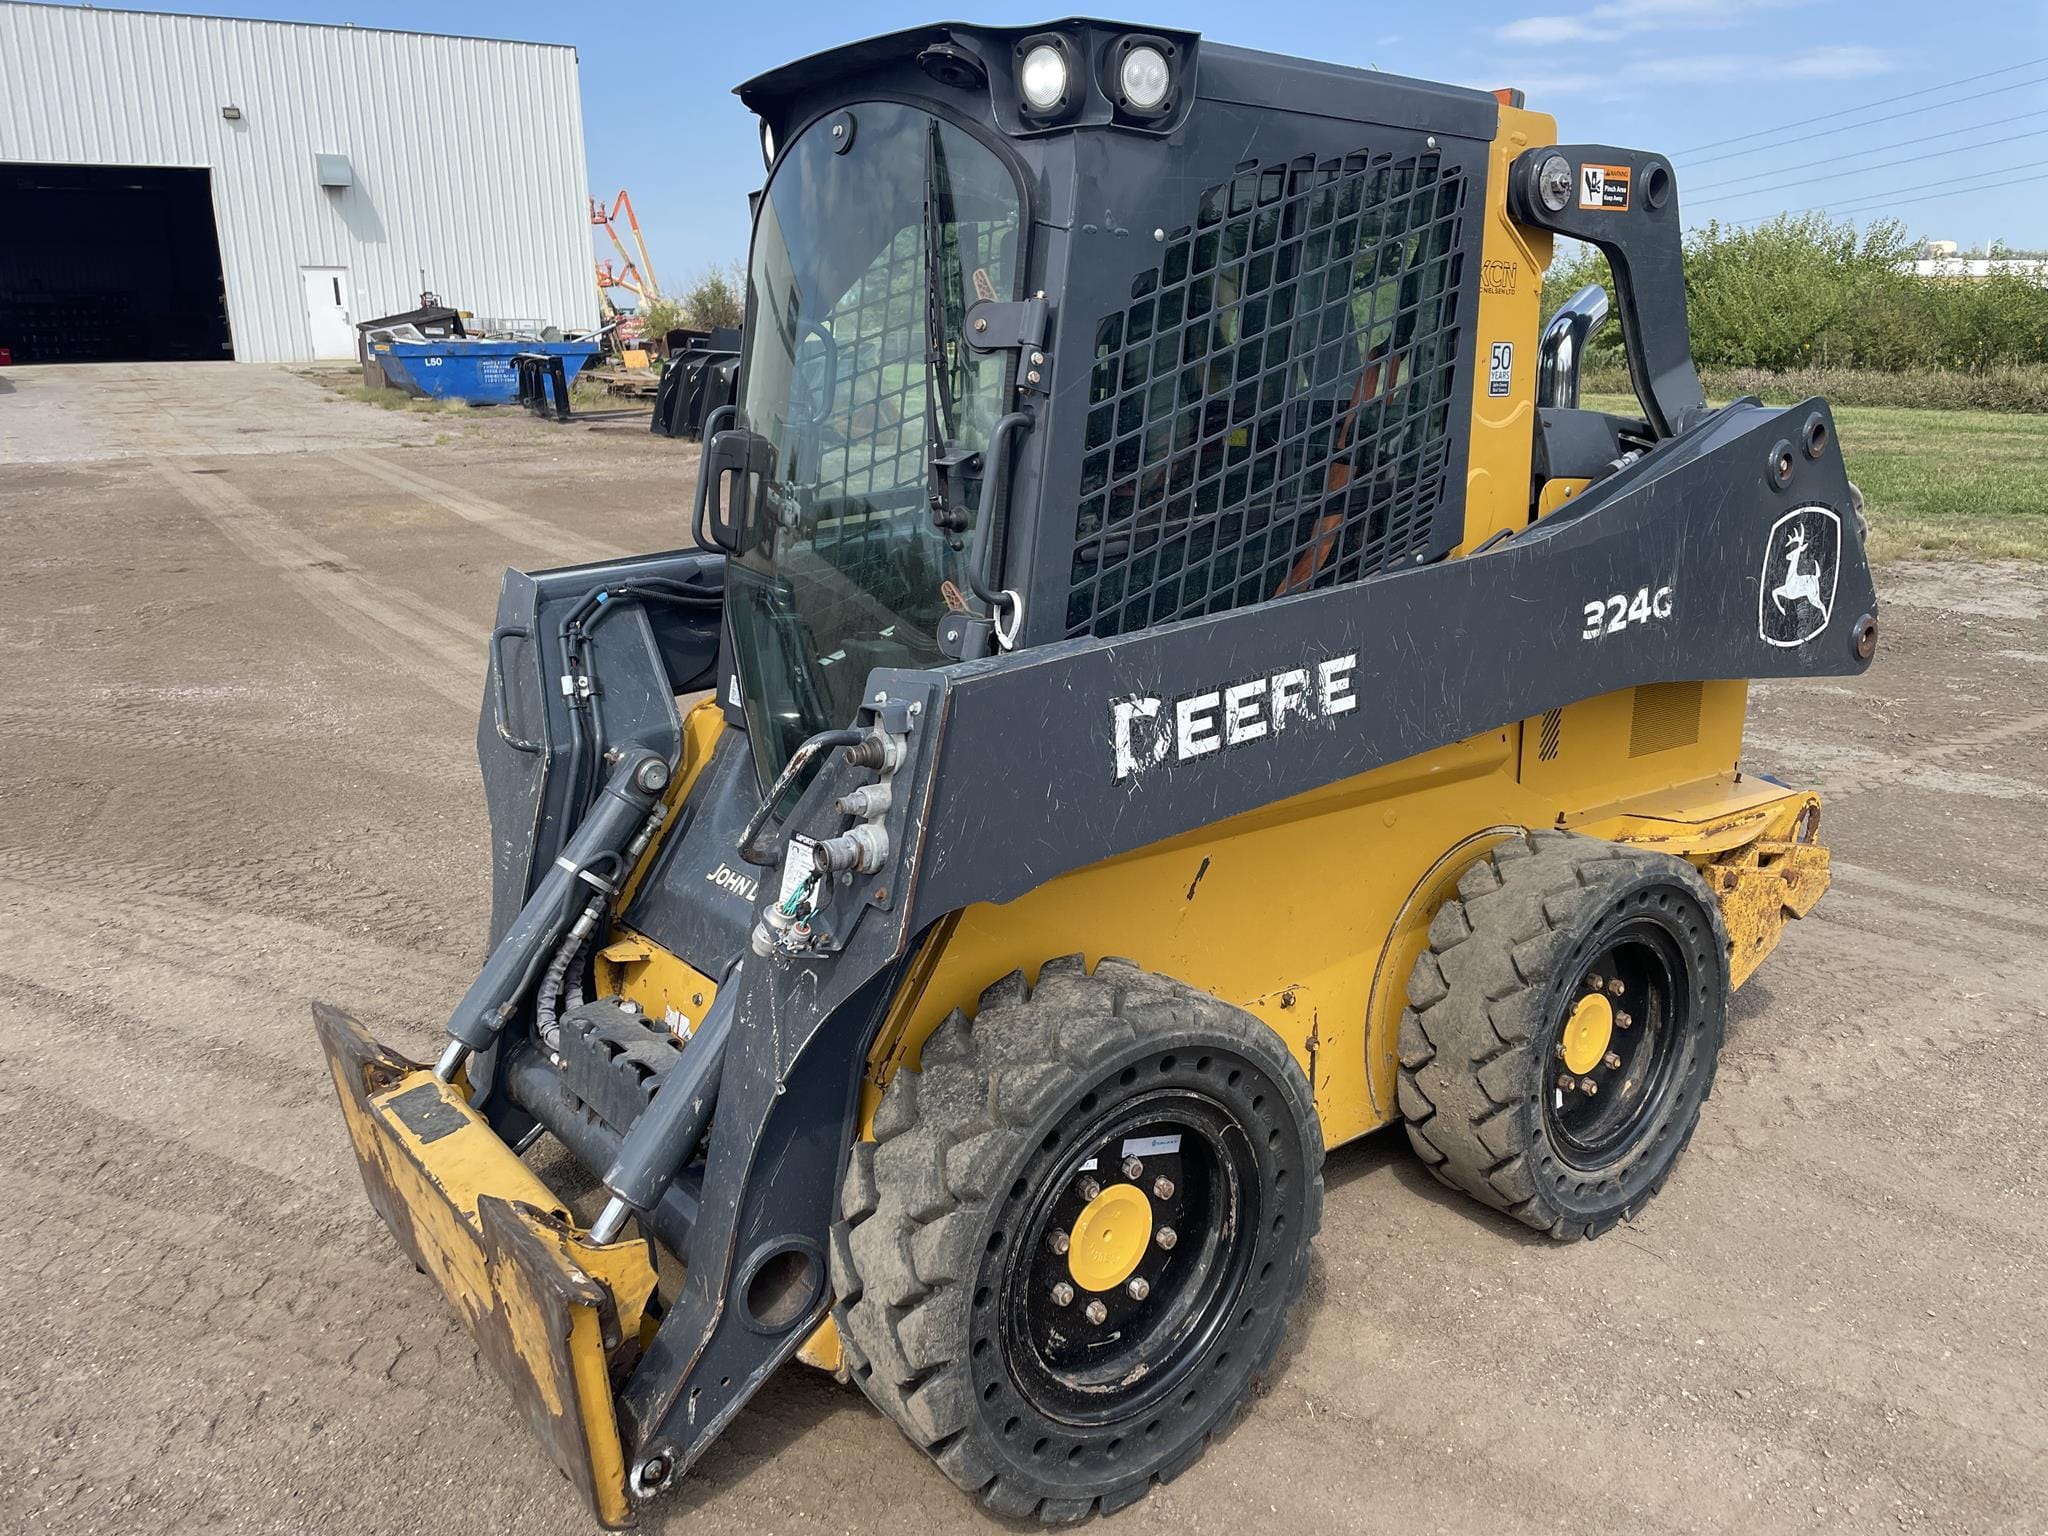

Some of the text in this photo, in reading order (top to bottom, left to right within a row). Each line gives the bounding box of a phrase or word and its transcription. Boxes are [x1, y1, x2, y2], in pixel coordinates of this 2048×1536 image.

[424, 357, 443, 367] L50
[1491, 345, 1511, 370] 50
[1491, 371, 1510, 380] YEARS
[1582, 586, 1673, 640] 324G
[1109, 653, 1356, 779] DEERE
[706, 862, 752, 897] JOHN
